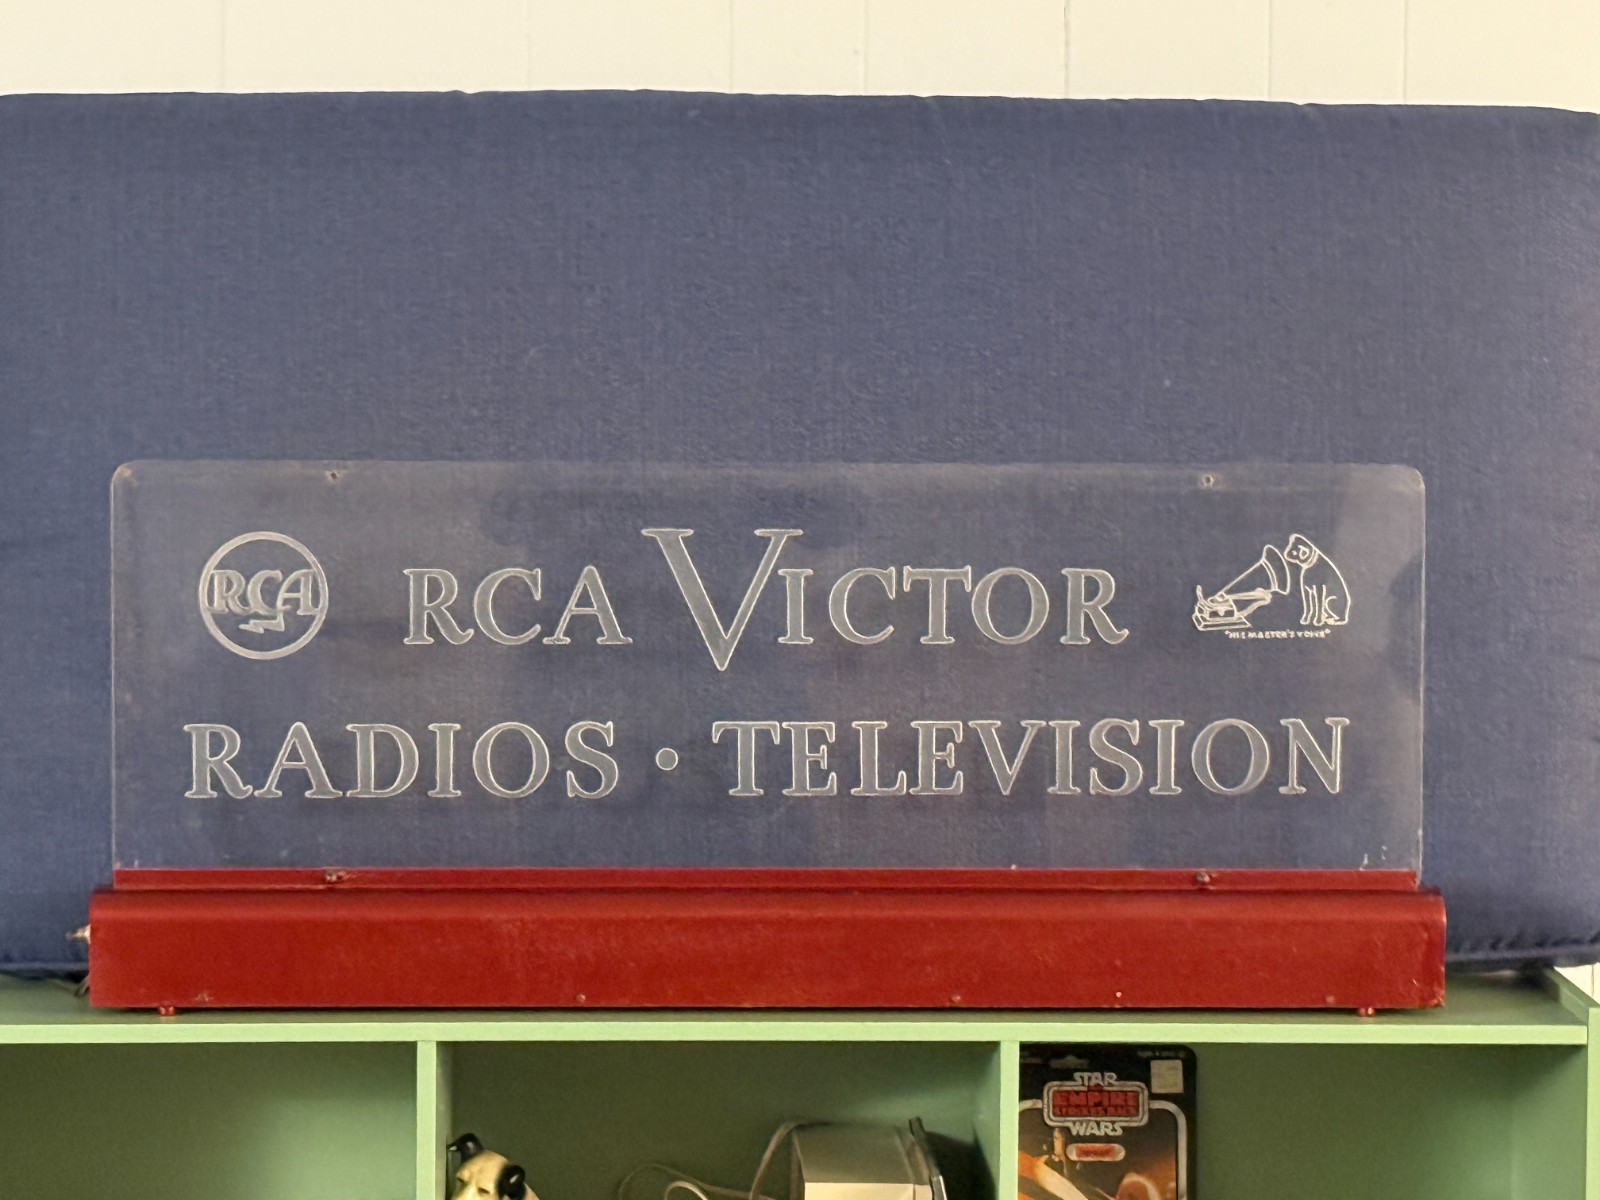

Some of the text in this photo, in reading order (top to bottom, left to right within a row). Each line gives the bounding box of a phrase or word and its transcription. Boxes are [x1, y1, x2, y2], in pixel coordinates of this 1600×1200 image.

[206, 568, 319, 617] RCA
[402, 565, 633, 646] RCA
[183, 716, 1351, 800] RADIOS TELEVISION
[1073, 1071, 1118, 1087] STAR
[1069, 1121, 1124, 1136] WARS
